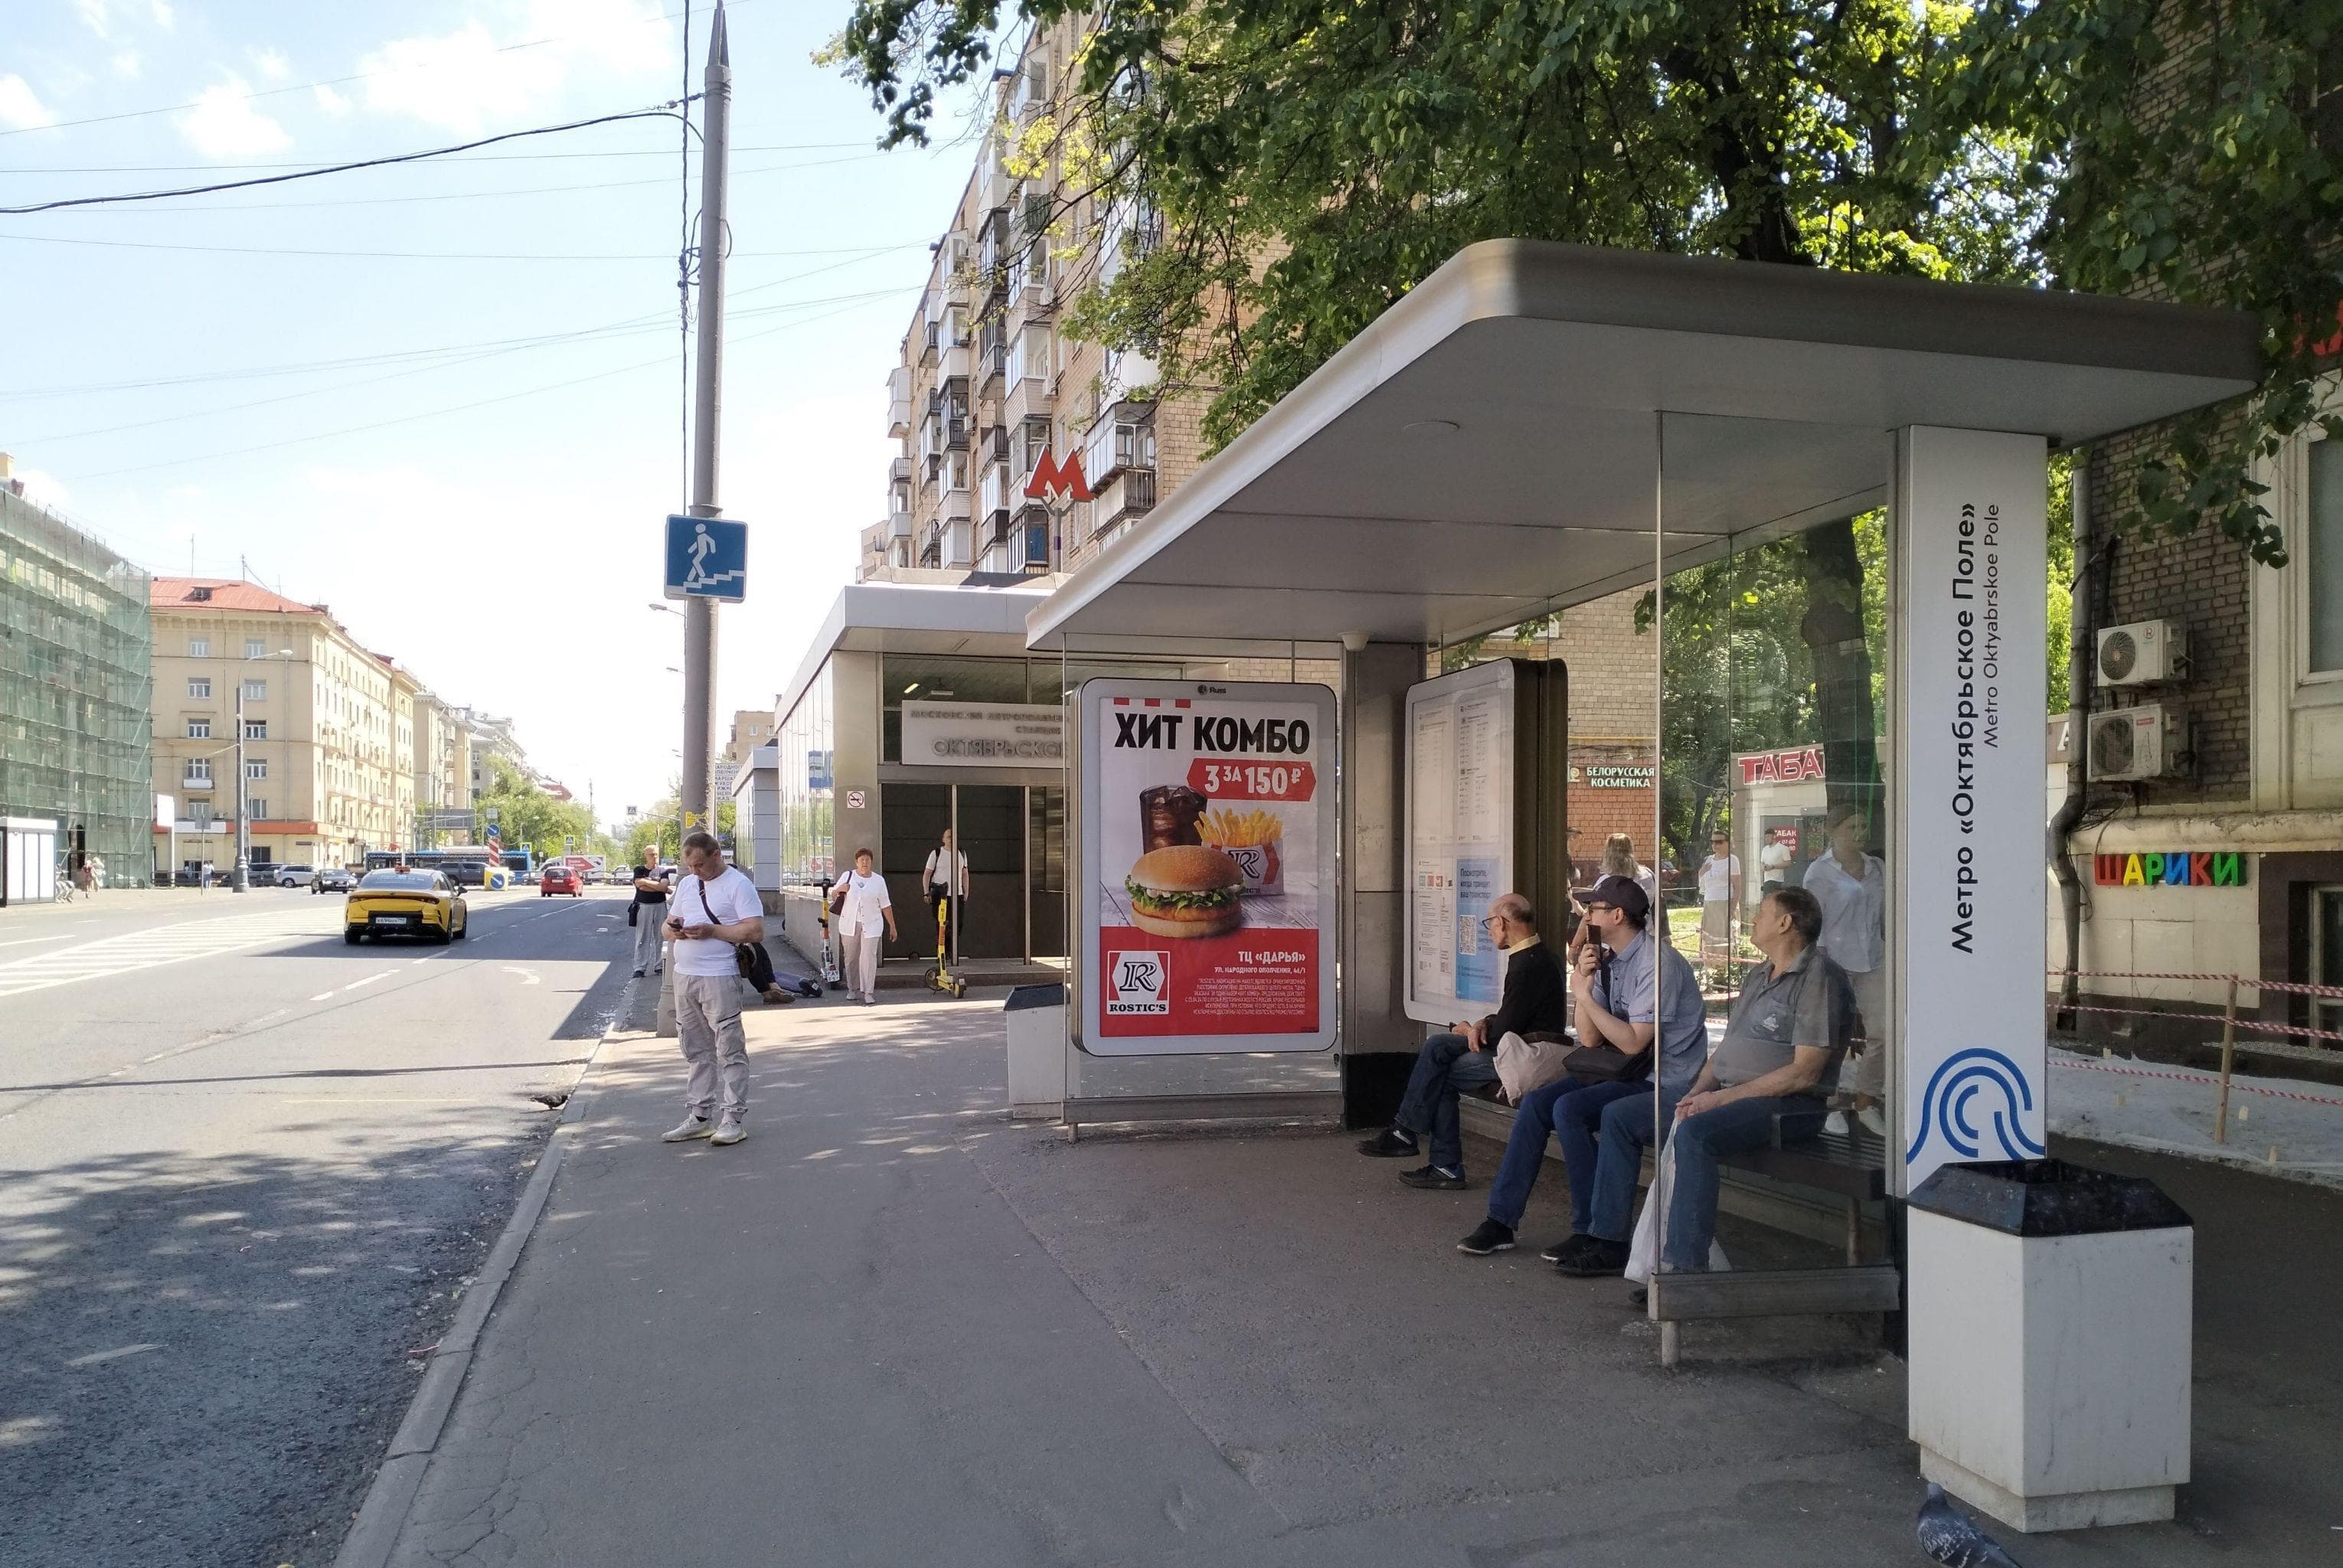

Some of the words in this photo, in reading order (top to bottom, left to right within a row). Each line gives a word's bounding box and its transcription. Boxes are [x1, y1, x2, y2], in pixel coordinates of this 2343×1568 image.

[1024, 445, 1095, 502] М
[1984, 505, 1998, 546] Pole
[1952, 503, 1975, 599] Поле»
[1983, 554, 2001, 678] Oktyabrskoe
[1114, 713, 1183, 750] ХИТ
[1194, 717, 1310, 754] КОМБО
[1952, 610, 1979, 834] «Октябрьское
[1984, 687, 1998, 748] Metro
[1204, 766, 1219, 792] 3
[1224, 766, 1242, 782] ЗА
[1244, 766, 1288, 795] 150
[1587, 766, 1655, 776] БЕЛОРУССКАЯ
[1591, 778, 1650, 787] КОСМЕТИКА
[1738, 749, 1825, 785] ТАБА
[2094, 852, 2240, 886] ШАРИКИ
[1952, 847, 1978, 954] Метро
[1119, 962, 1157, 991] R
[1238, 951, 1253, 964] ТЦ
[1256, 951, 1305, 964] «ДАРЬЯ»
[1109, 1004, 1166, 1012] ROSTIC'S
